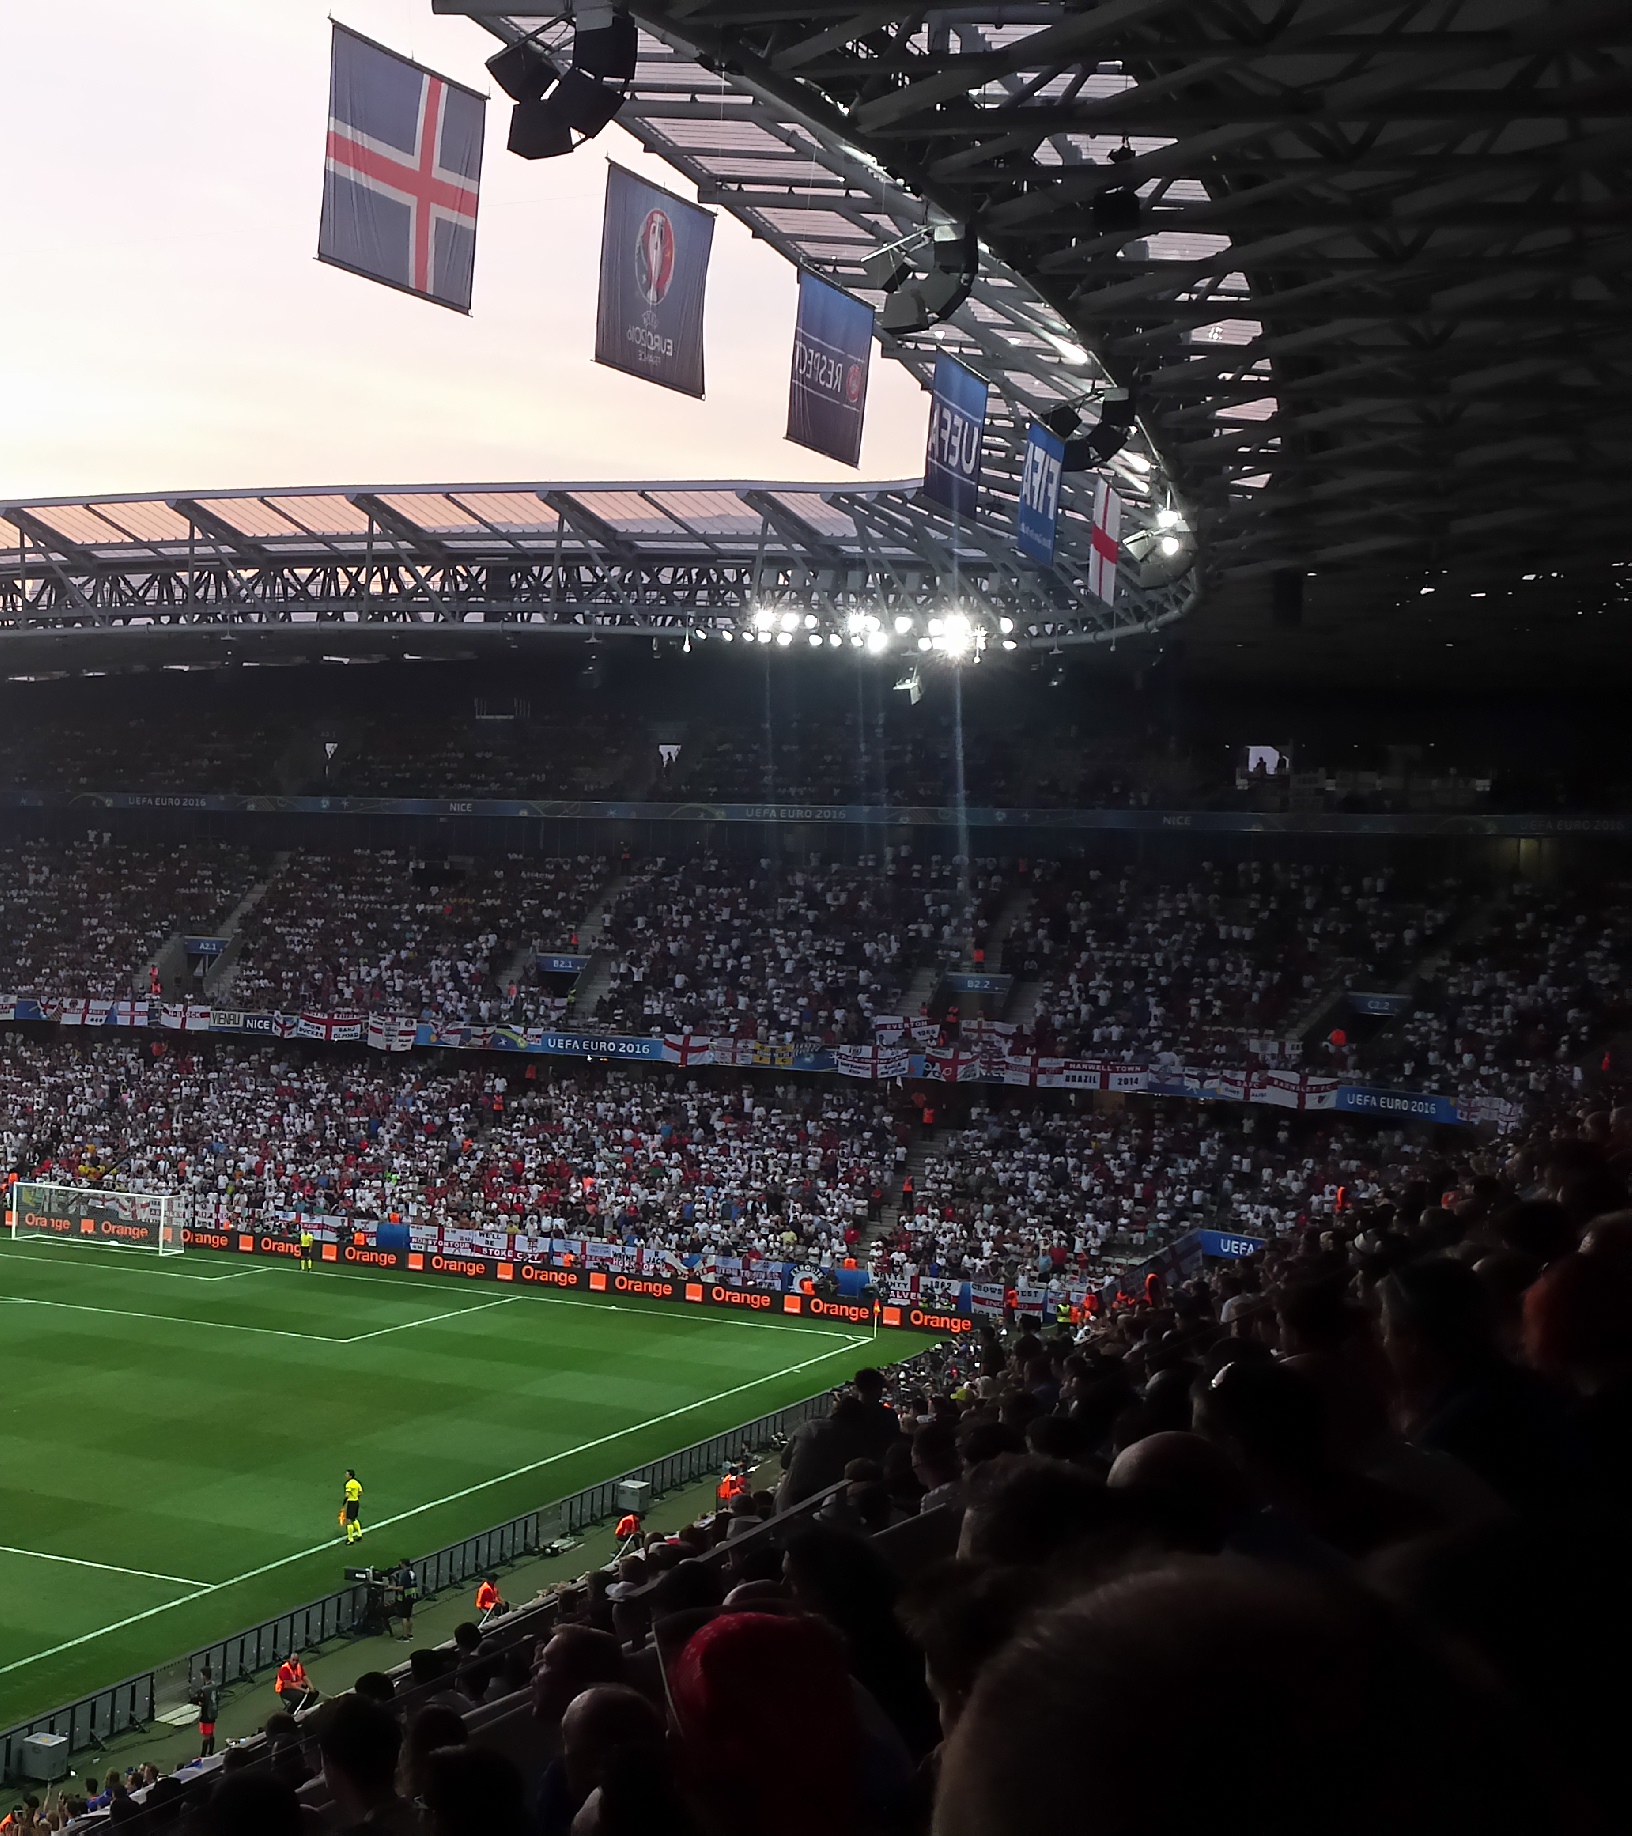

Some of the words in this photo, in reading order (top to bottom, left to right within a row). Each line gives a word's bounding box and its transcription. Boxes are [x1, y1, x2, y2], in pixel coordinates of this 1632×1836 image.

[128, 796, 153, 806] UEFA
[154, 797, 181, 807] EURO
[182, 798, 207, 807] 2016
[449, 802, 473, 812] NICE
[746, 807, 777, 818] UEFA
[779, 809, 813, 819] EURO
[814, 809, 846, 819] 2016
[1162, 815, 1192, 826] NICE
[199, 942, 217, 951] A2.1
[553, 959, 573, 969] B2.1
[967, 980, 990, 989] B2.2
[246, 1019, 270, 1030] NICE
[886, 1020, 928, 1030] EVERTON
[547, 1037, 580, 1050] UEFA
[582, 1040, 616, 1052] EURO
[618, 1042, 650, 1055] 2016
[1069, 1062, 1113, 1072] HANWELL
[1065, 1074, 1097, 1085] BRAZIL
[1117, 1076, 1139, 1086] 2014
[1273, 1080, 1318, 1092] BARNSLEY
[1346, 1093, 1377, 1107] UEFA
[1379, 1096, 1409, 1111] EURO
[1411, 1098, 1437, 1114] 2016
[101, 1219, 148, 1240] Orange
[179, 1228, 229, 1250] Orange
[261, 1237, 303, 1259] Orang
[1220, 1237, 1255, 1255] UEFA
[344, 1245, 398, 1268] Orange
[481, 1247, 514, 1258] STOKE
[517, 1252, 541, 1261] CTY
[430, 1254, 486, 1278] Orange
[521, 1264, 578, 1288] Orange
[614, 1275, 673, 1299] Orange
[971, 1283, 1003, 1295] CROWS
[710, 1286, 772, 1310] Orange
[809, 1297, 871, 1322] Orange
[910, 1308, 973, 1334] Orange
